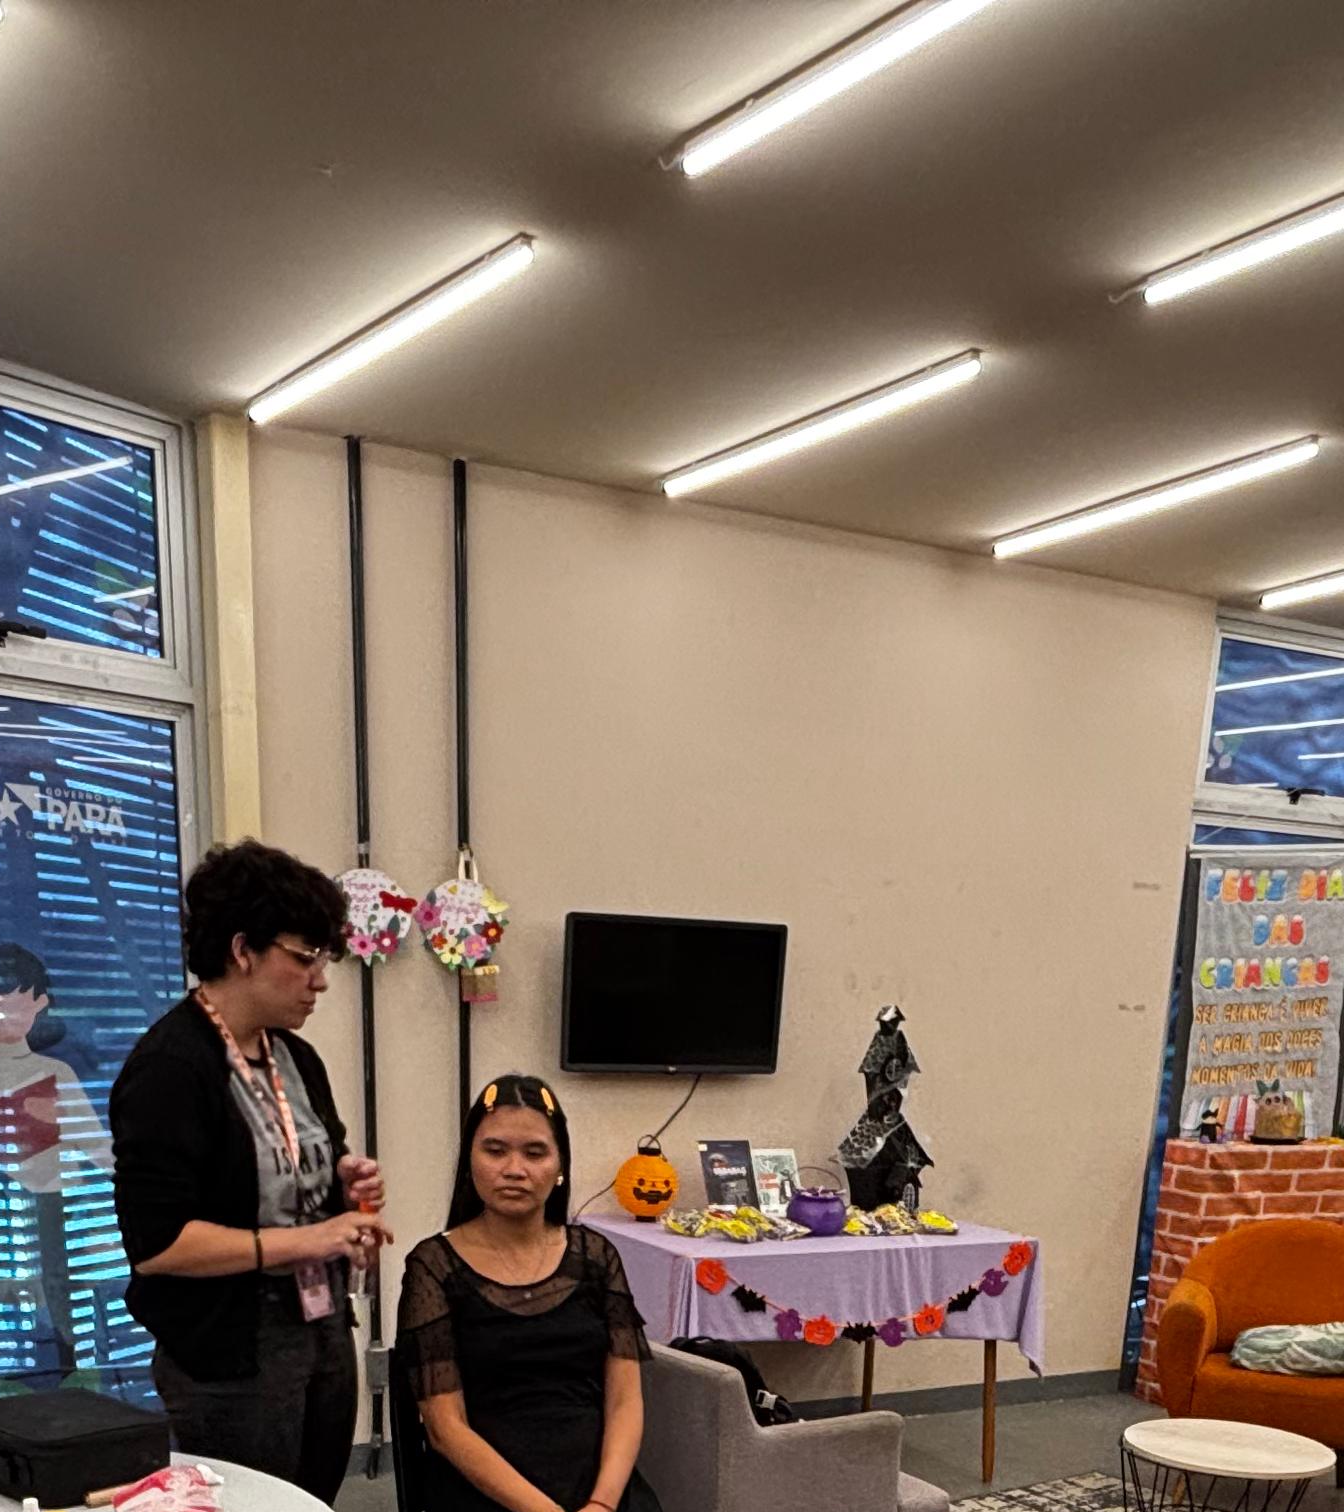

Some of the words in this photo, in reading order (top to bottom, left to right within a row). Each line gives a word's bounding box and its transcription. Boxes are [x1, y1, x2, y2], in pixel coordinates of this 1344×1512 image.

[45, 786, 102, 801] GOVERNO
[1205, 868, 1288, 903] FELIZ
[1252, 914, 1305, 947] DAS
